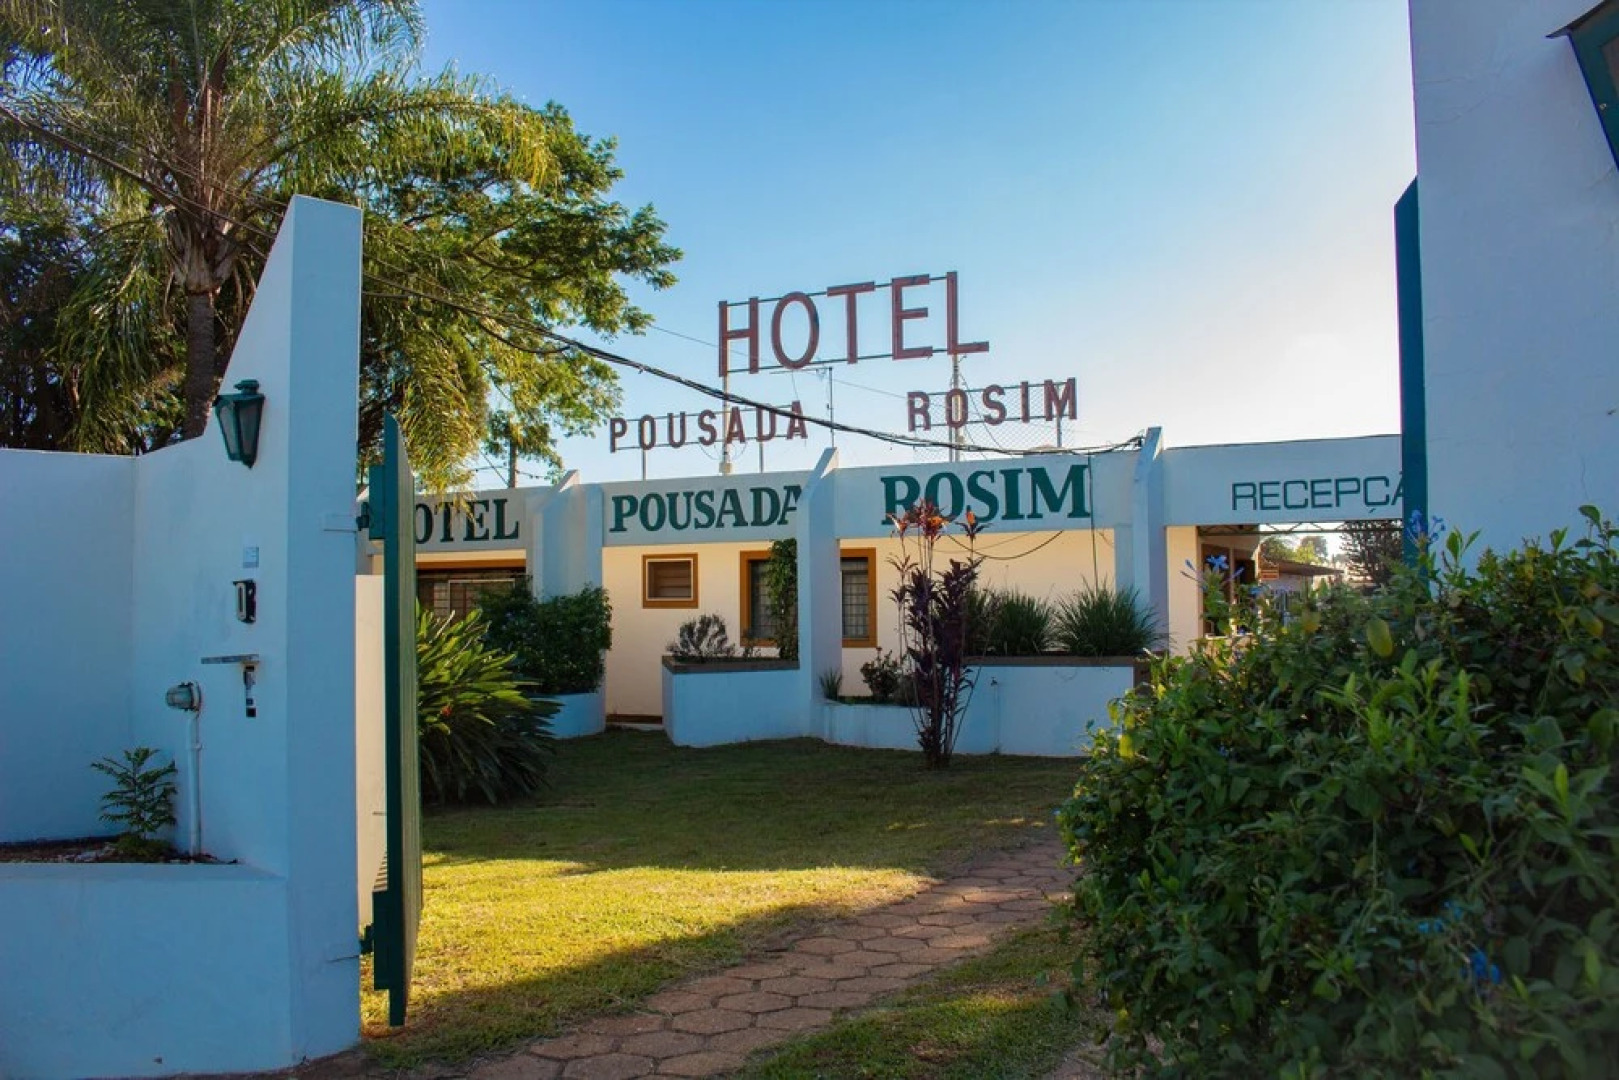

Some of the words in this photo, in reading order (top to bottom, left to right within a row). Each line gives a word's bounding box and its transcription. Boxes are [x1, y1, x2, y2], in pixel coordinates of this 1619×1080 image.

[718, 271, 989, 377] HOTEL
[610, 400, 808, 452] POUSADA
[907, 377, 1076, 431] ROSIM
[415, 499, 519, 544] OTEL
[609, 484, 802, 531] POUSADA
[881, 464, 1091, 526] ROSIM
